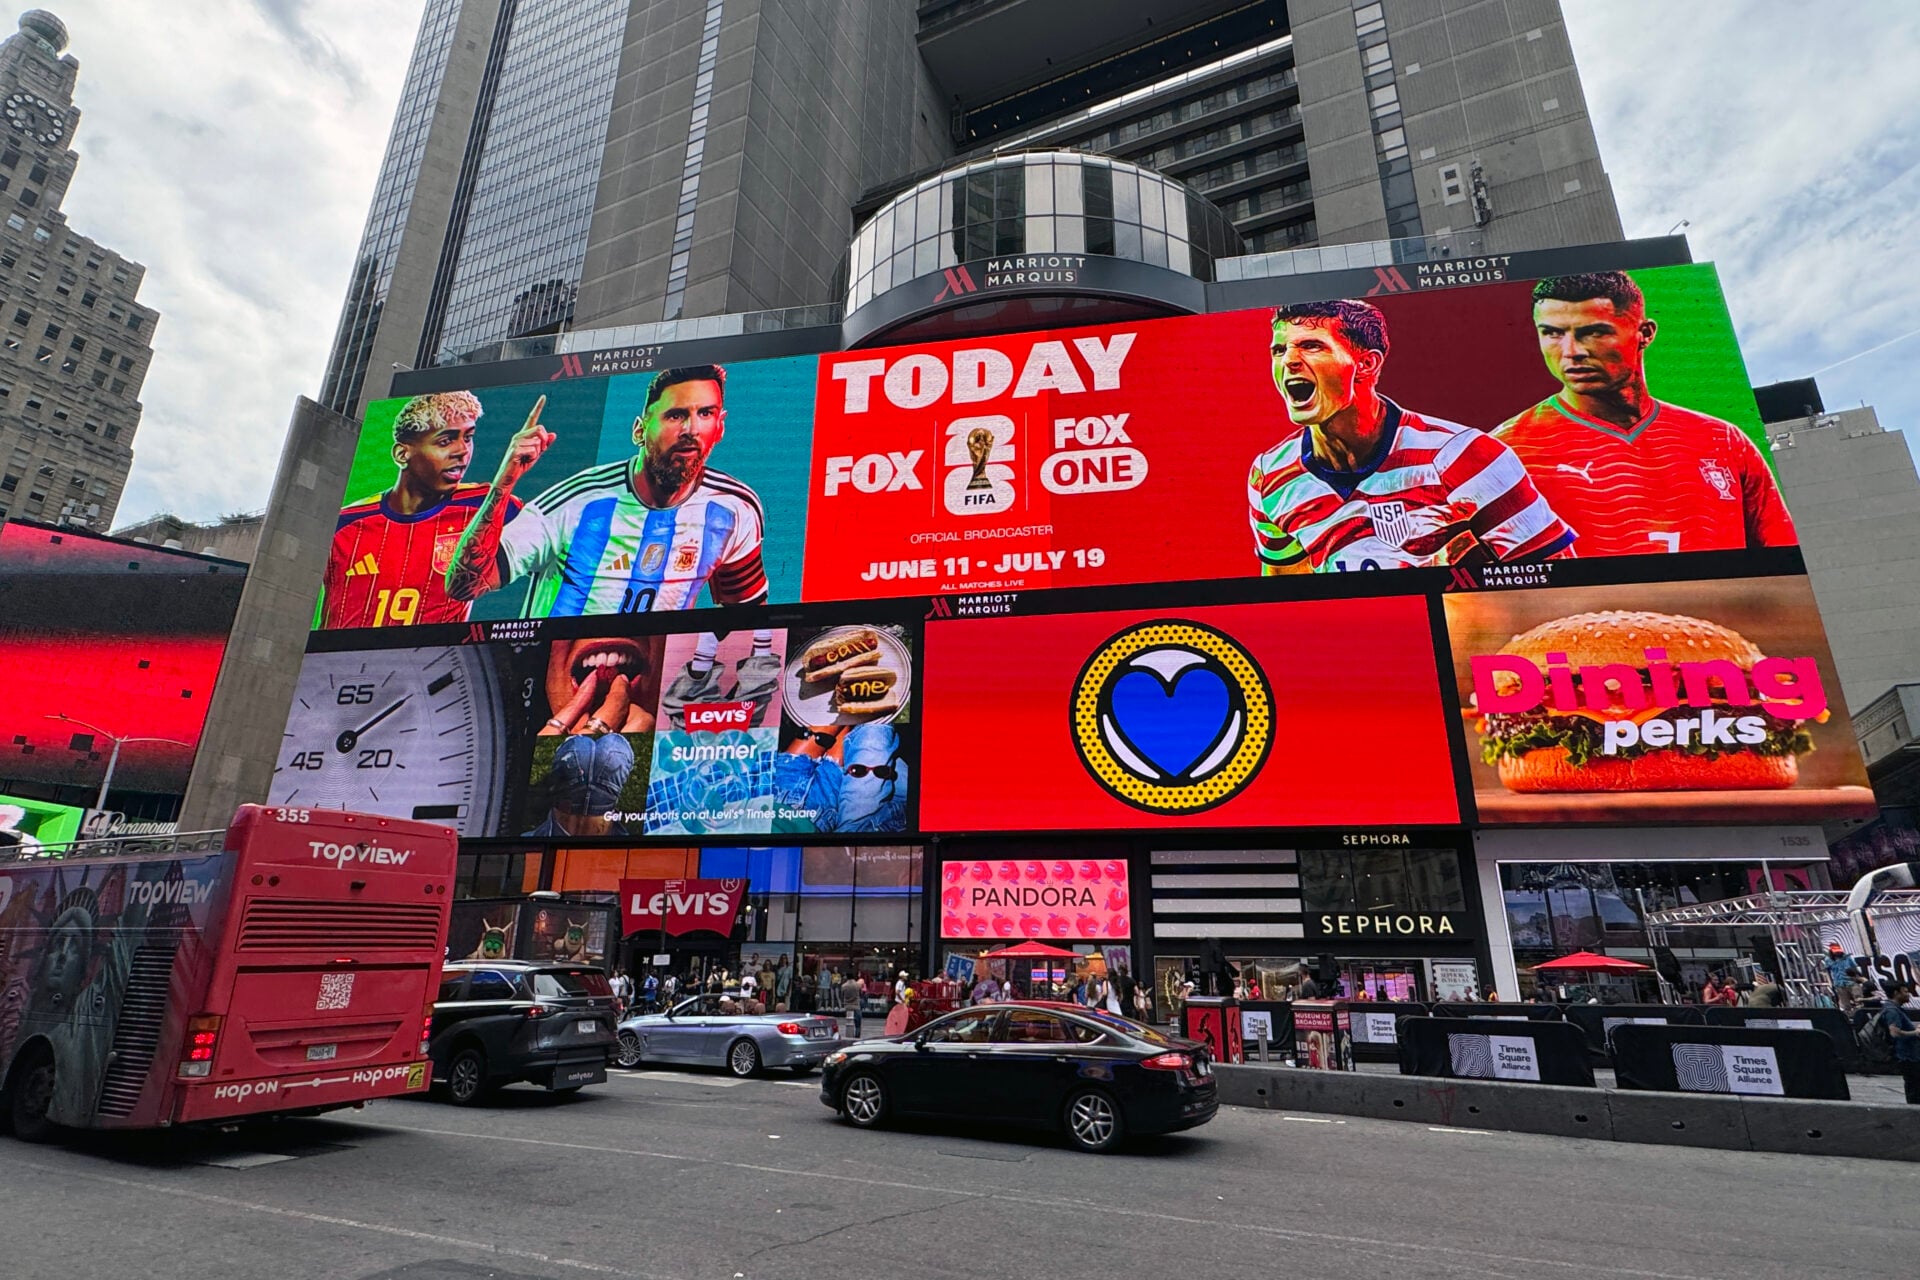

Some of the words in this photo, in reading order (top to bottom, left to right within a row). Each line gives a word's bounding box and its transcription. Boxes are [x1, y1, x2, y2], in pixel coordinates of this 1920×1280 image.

[988, 257, 1086, 272] MARRIOTT
[1418, 256, 1511, 275] MARRIOTT
[987, 271, 1074, 286] MARQUIS
[1420, 270, 1503, 287] MARQUIS
[593, 346, 664, 361] MARRIOTT
[591, 358, 654, 373] MARQUIS
[831, 332, 1138, 414] TODAY
[1054, 413, 1132, 449] FOX
[824, 449, 925, 497] FOX
[1052, 454, 1133, 487] ONE
[964, 494, 996, 506] FIFA
[910, 531, 961, 545] OFFICIAL
[964, 525, 1053, 541] BROADCASTER
[860, 558, 937, 581] JUNE
[943, 556, 970, 576] 11
[993, 550, 1067, 573] JULY
[1073, 548, 1105, 568] 19
[1482, 563, 1554, 576] MARRIOTT
[940, 583, 957, 591] ALL
[959, 580, 1003, 589] MATCHES
[1004, 579, 1025, 587] LIVE
[1484, 574, 1548, 587] MARQUIS
[958, 593, 1018, 605] MARRIOTT
[373, 588, 420, 628] 19
[958, 604, 1011, 615] MARQUIS
[492, 620, 543, 631] MARRIOTT
[490, 630, 535, 640] MARQUIS
[826, 639, 873, 663] call
[849, 680, 889, 697] me
[1469, 647, 1828, 720] Dining
[337, 684, 375, 705] 65
[1603, 711, 1768, 755] perks
[357, 749, 393, 769] 20
[672, 743, 758, 762] summer
[290, 751, 324, 771] 45
[275, 808, 310, 824] 355
[603, 811, 622, 822] Get
[625, 812, 647, 824] your
[649, 810, 679, 821] shorts
[682, 811, 696, 820] on
[698, 810, 710, 820] at
[746, 808, 776, 819] Times
[778, 808, 817, 820] Square
[1343, 834, 1410, 845] SEPHORA
[1780, 836, 1811, 847] 1535
[130, 879, 215, 918] TOPVIEW
[972, 887, 1096, 907] PANDORA
[1321, 915, 1455, 934] SEPHORA
[1295, 1012, 1322, 1020] MUSEUM
[1372, 1018, 1391, 1026] Times
[1498, 1044, 1528, 1054] Times
[1498, 1053, 1531, 1063] Square
[1733, 1055, 1768, 1066] Times
[1501, 1062, 1531, 1071] Alliance
[1732, 1065, 1772, 1076] Square
[352, 1071, 383, 1087] HOP
[384, 1066, 410, 1079] OFF
[1737, 1075, 1773, 1084] Alliance
[214, 1084, 251, 1103] HOP
[254, 1081, 278, 1095] ON
